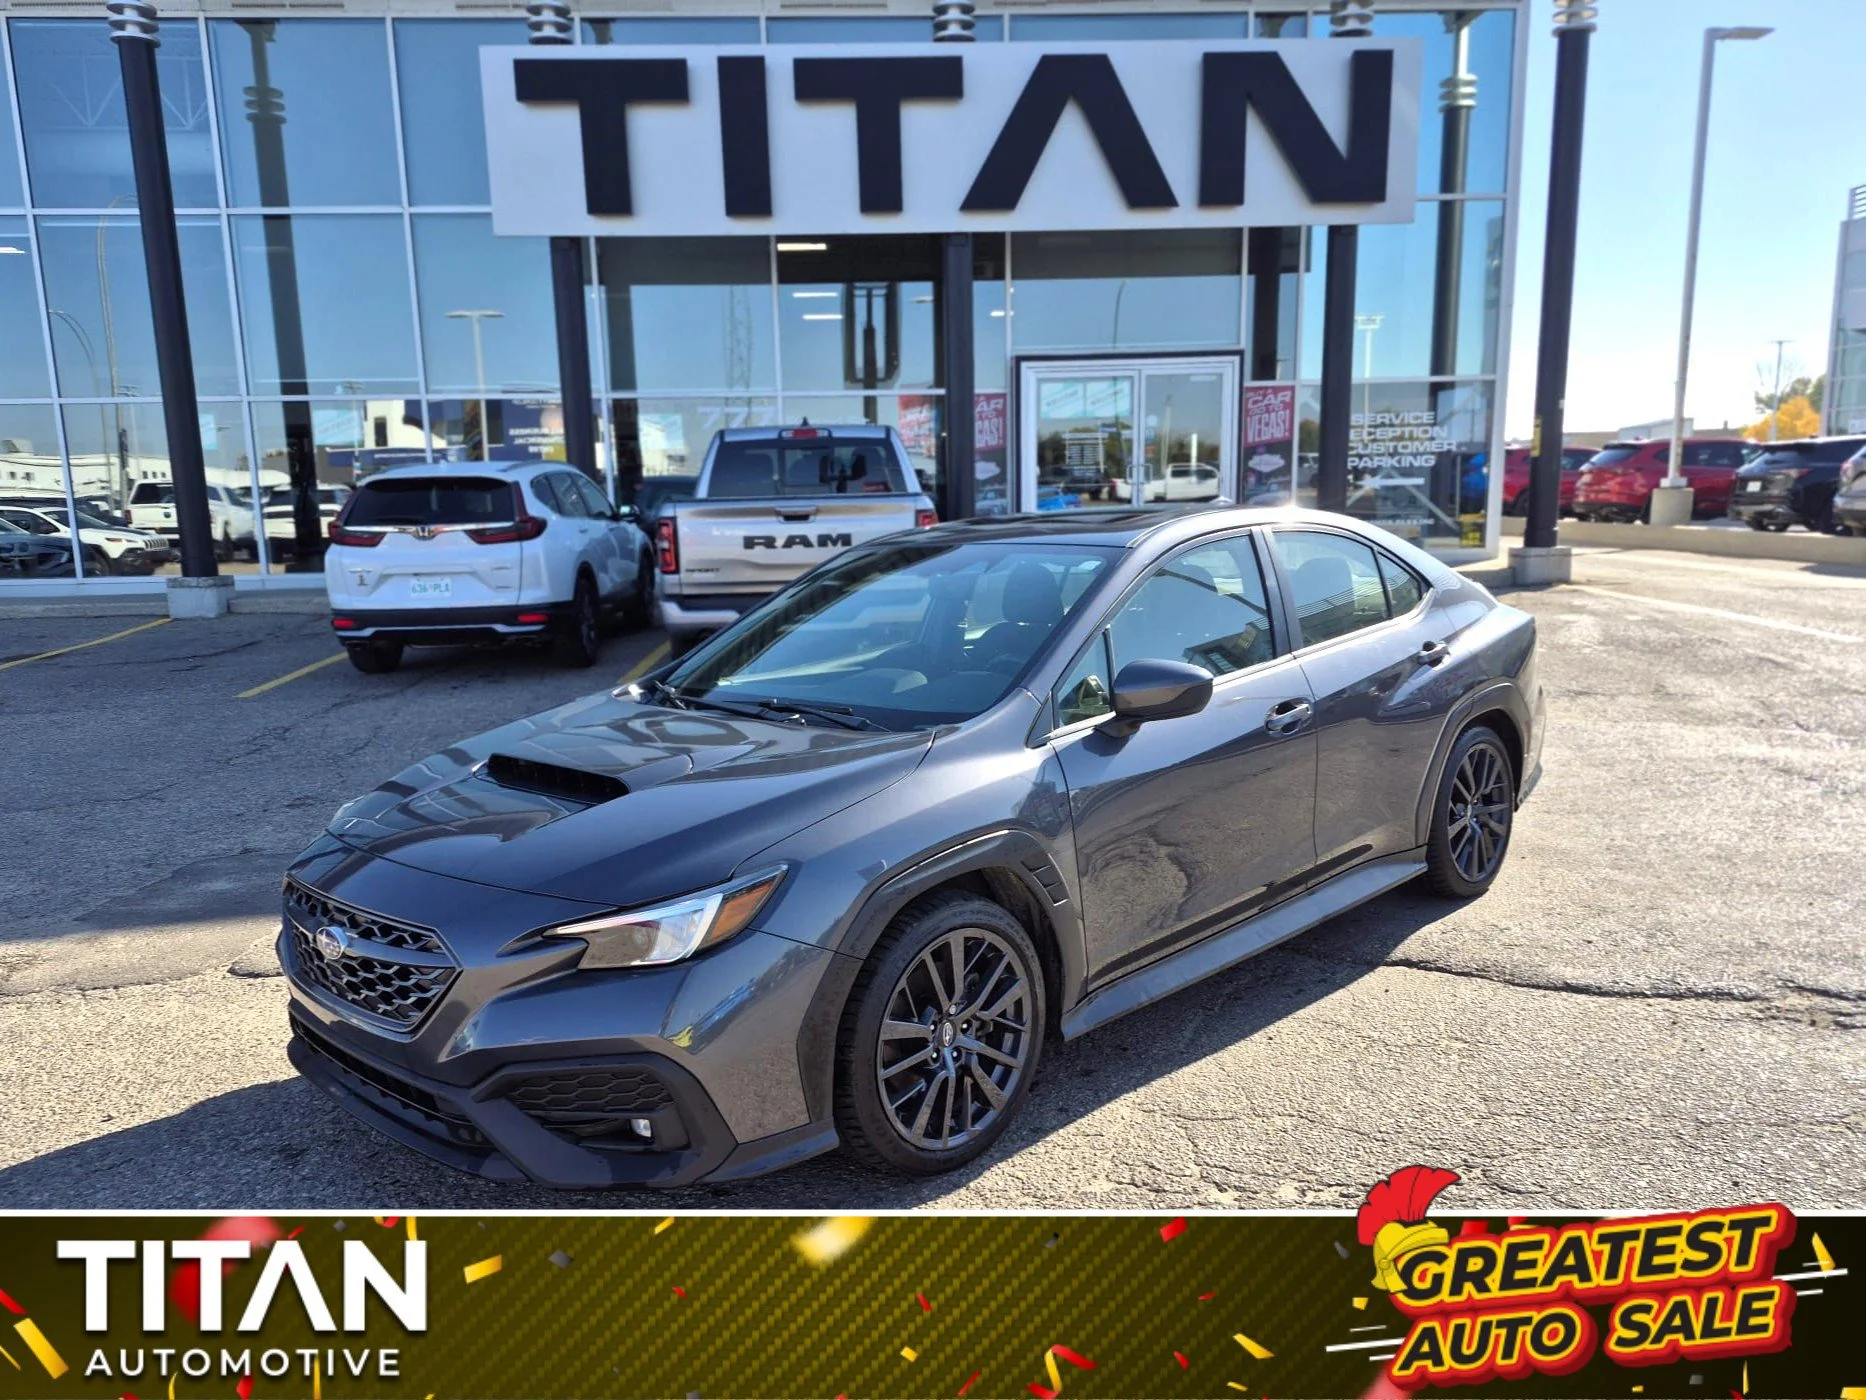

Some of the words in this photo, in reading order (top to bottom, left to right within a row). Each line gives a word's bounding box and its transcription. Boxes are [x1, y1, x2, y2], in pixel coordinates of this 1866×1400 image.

[513, 49, 1394, 216] TITAN
[976, 398, 1004, 413] AR
[1248, 391, 1292, 409] CAR
[1247, 409, 1290, 443] VEGAS!
[1351, 411, 1436, 425] SERVICE
[1350, 424, 1449, 440] ECEPTION
[1347, 454, 1436, 470] PARKING
[743, 533, 852, 550] RAM
